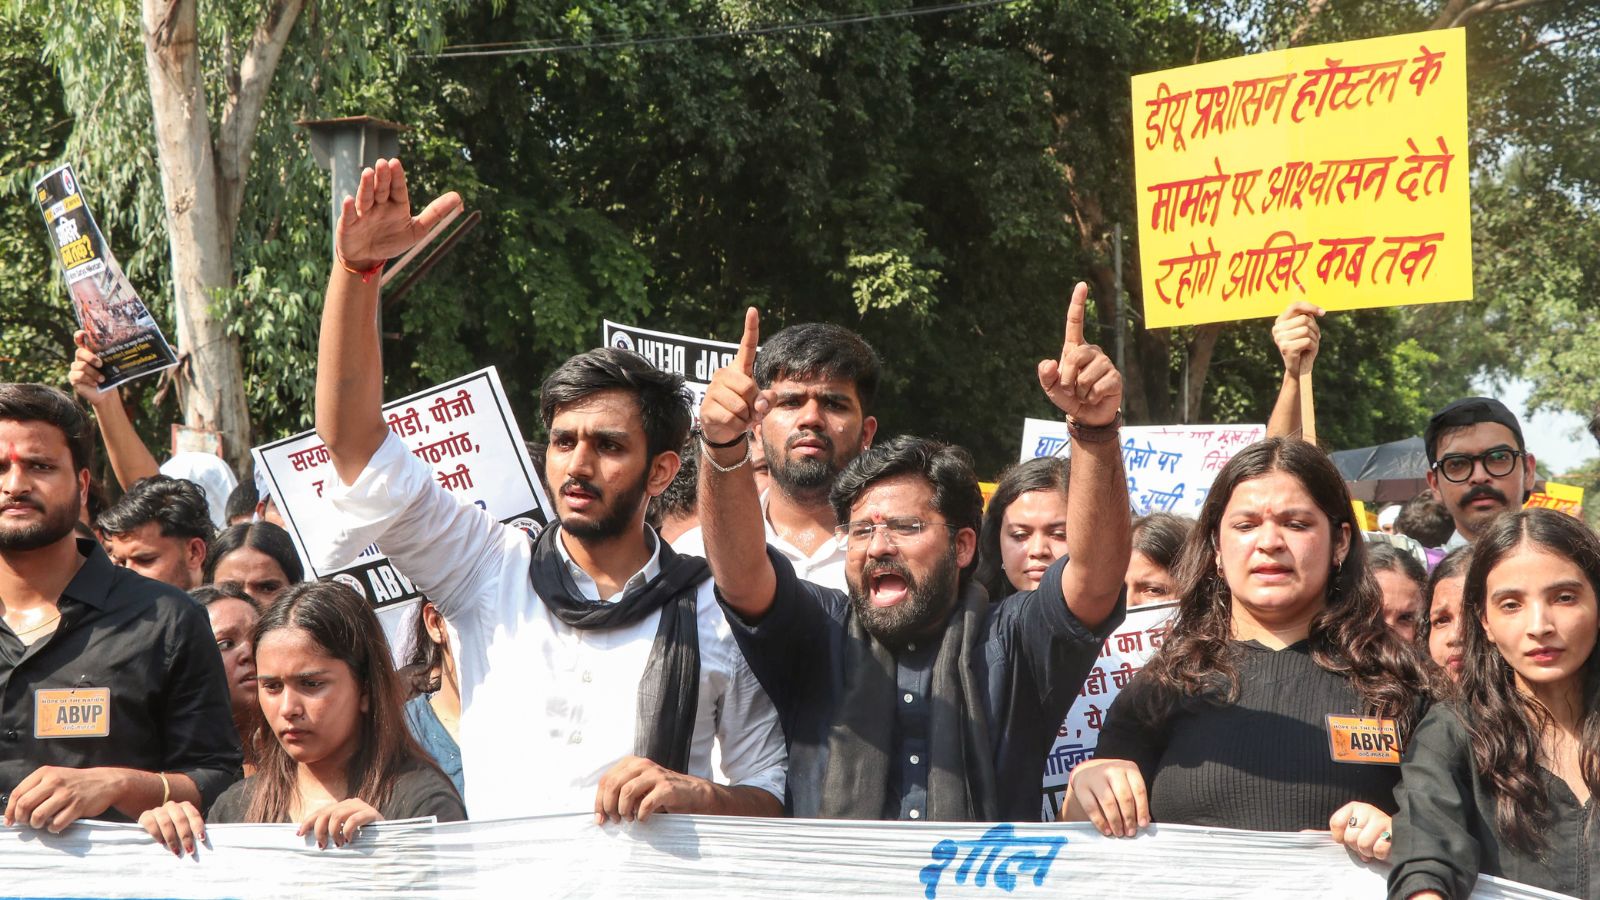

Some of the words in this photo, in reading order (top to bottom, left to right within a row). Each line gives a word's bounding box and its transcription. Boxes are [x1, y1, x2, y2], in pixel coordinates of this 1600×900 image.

[1145, 82, 1192, 152] डीयू
[1191, 73, 1297, 139] प्रशासन
[1291, 57, 1407, 123] हॉस्टल
[1409, 45, 1446, 97] के
[1147, 157, 1230, 234] मामले
[1232, 169, 1262, 216] पर
[1261, 155, 1398, 215] आश्वासन
[1395, 135, 1455, 202] देते
[1155, 237, 1221, 309] रहोगे
[1221, 230, 1314, 302] आखिर
[1316, 236, 1376, 287] कब
[1371, 232, 1445, 286] तक
[638, 338, 685, 377] DELHI
[288, 444, 331, 471] सरक
[429, 389, 476, 424] पीजी
[1121, 437, 1157, 471] ीखो
[1158, 450, 1183, 474] पर
[1200, 450, 1232, 472] निके
[366, 564, 418, 603] ABV
[1114, 630, 1143, 653] का
[1080, 666, 1107, 697] ही
[1110, 662, 1144, 689] ची
[56, 705, 103, 724] ABVP
[1084, 704, 1102, 731] ये
[1351, 732, 1394, 751] ABVP
